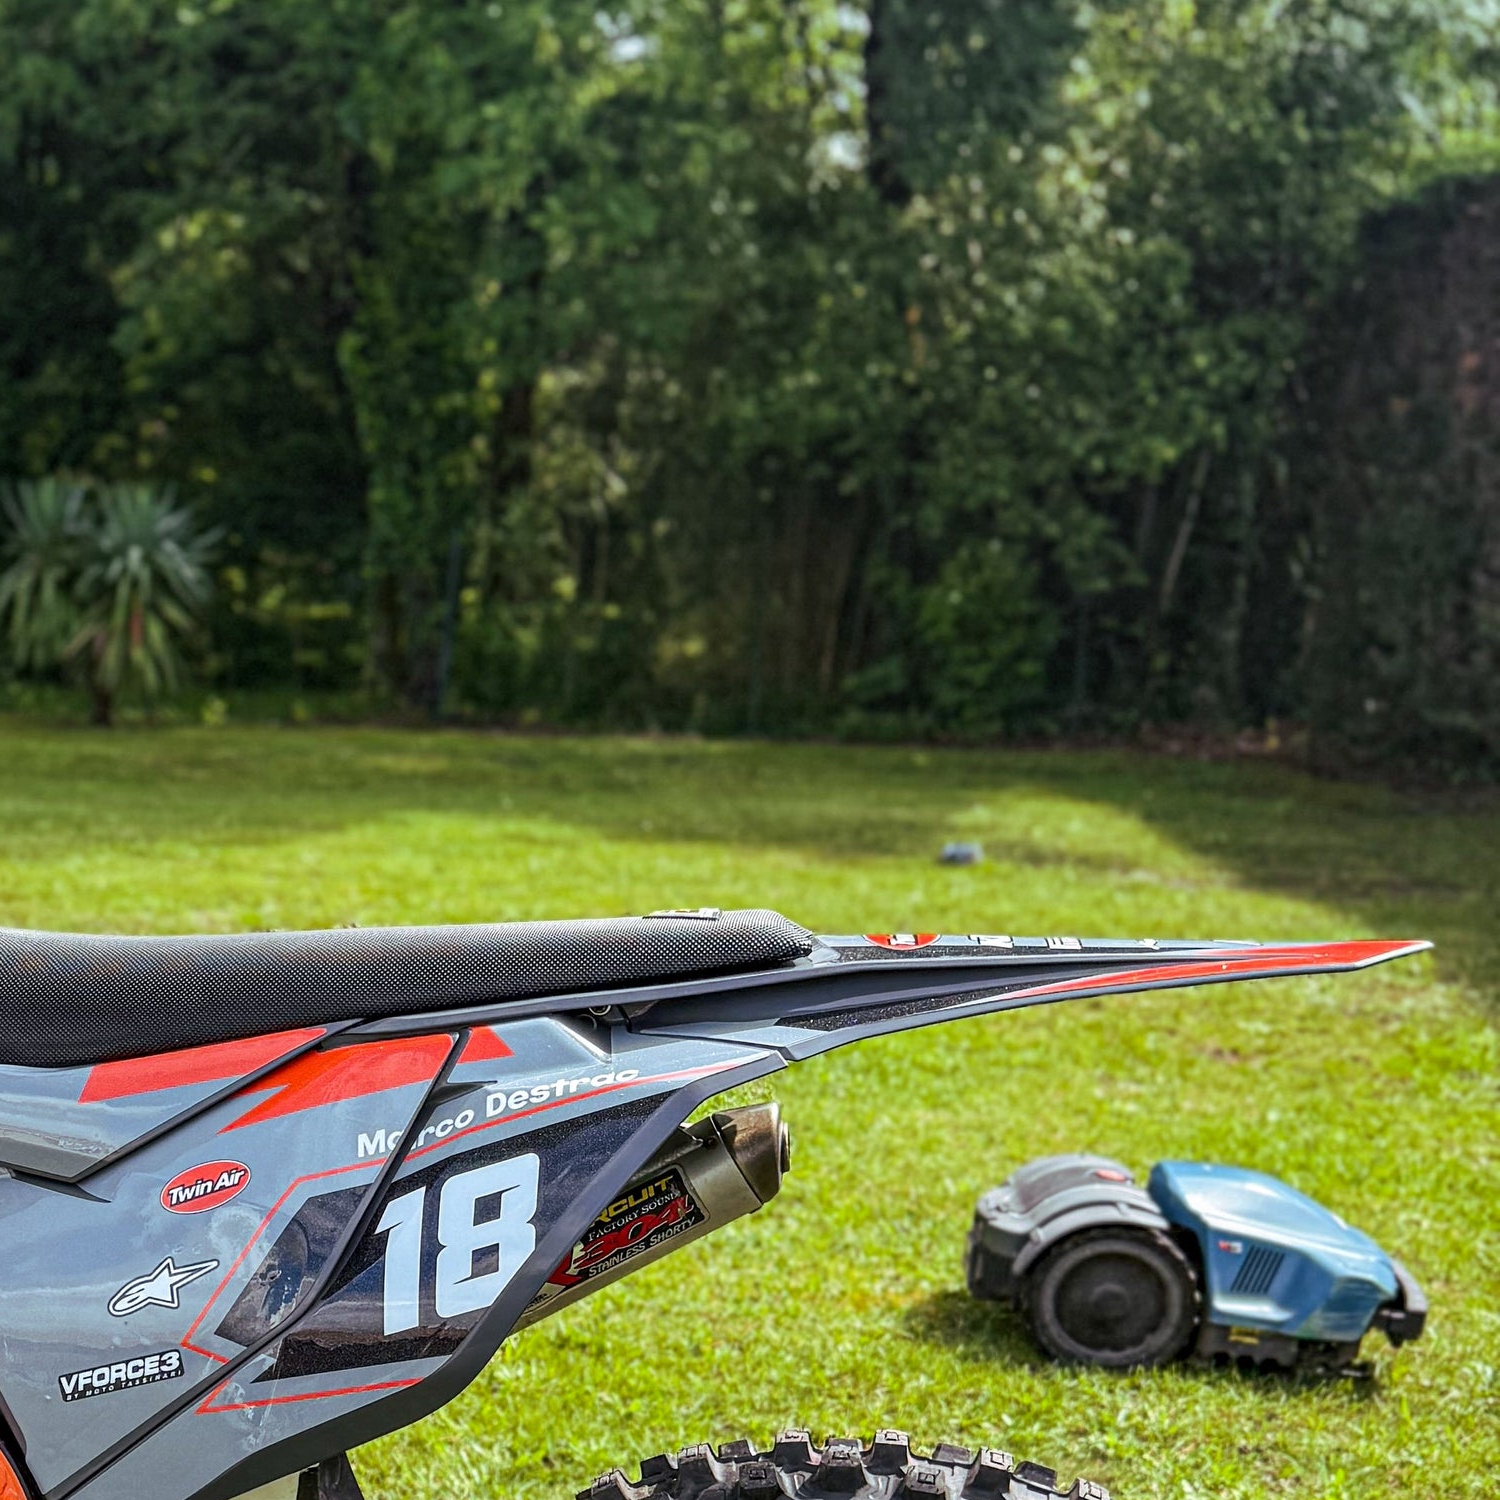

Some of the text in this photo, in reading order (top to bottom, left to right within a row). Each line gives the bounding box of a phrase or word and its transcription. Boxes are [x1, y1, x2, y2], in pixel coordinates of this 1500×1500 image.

[168, 1168, 246, 1206] Twin Air
[374, 1152, 540, 1336] 18
[588, 1216, 696, 1277] STAINLESS SHORTY
[60, 1351, 181, 1395] VFORCE3
[85, 1385, 115, 1397] MOTO
